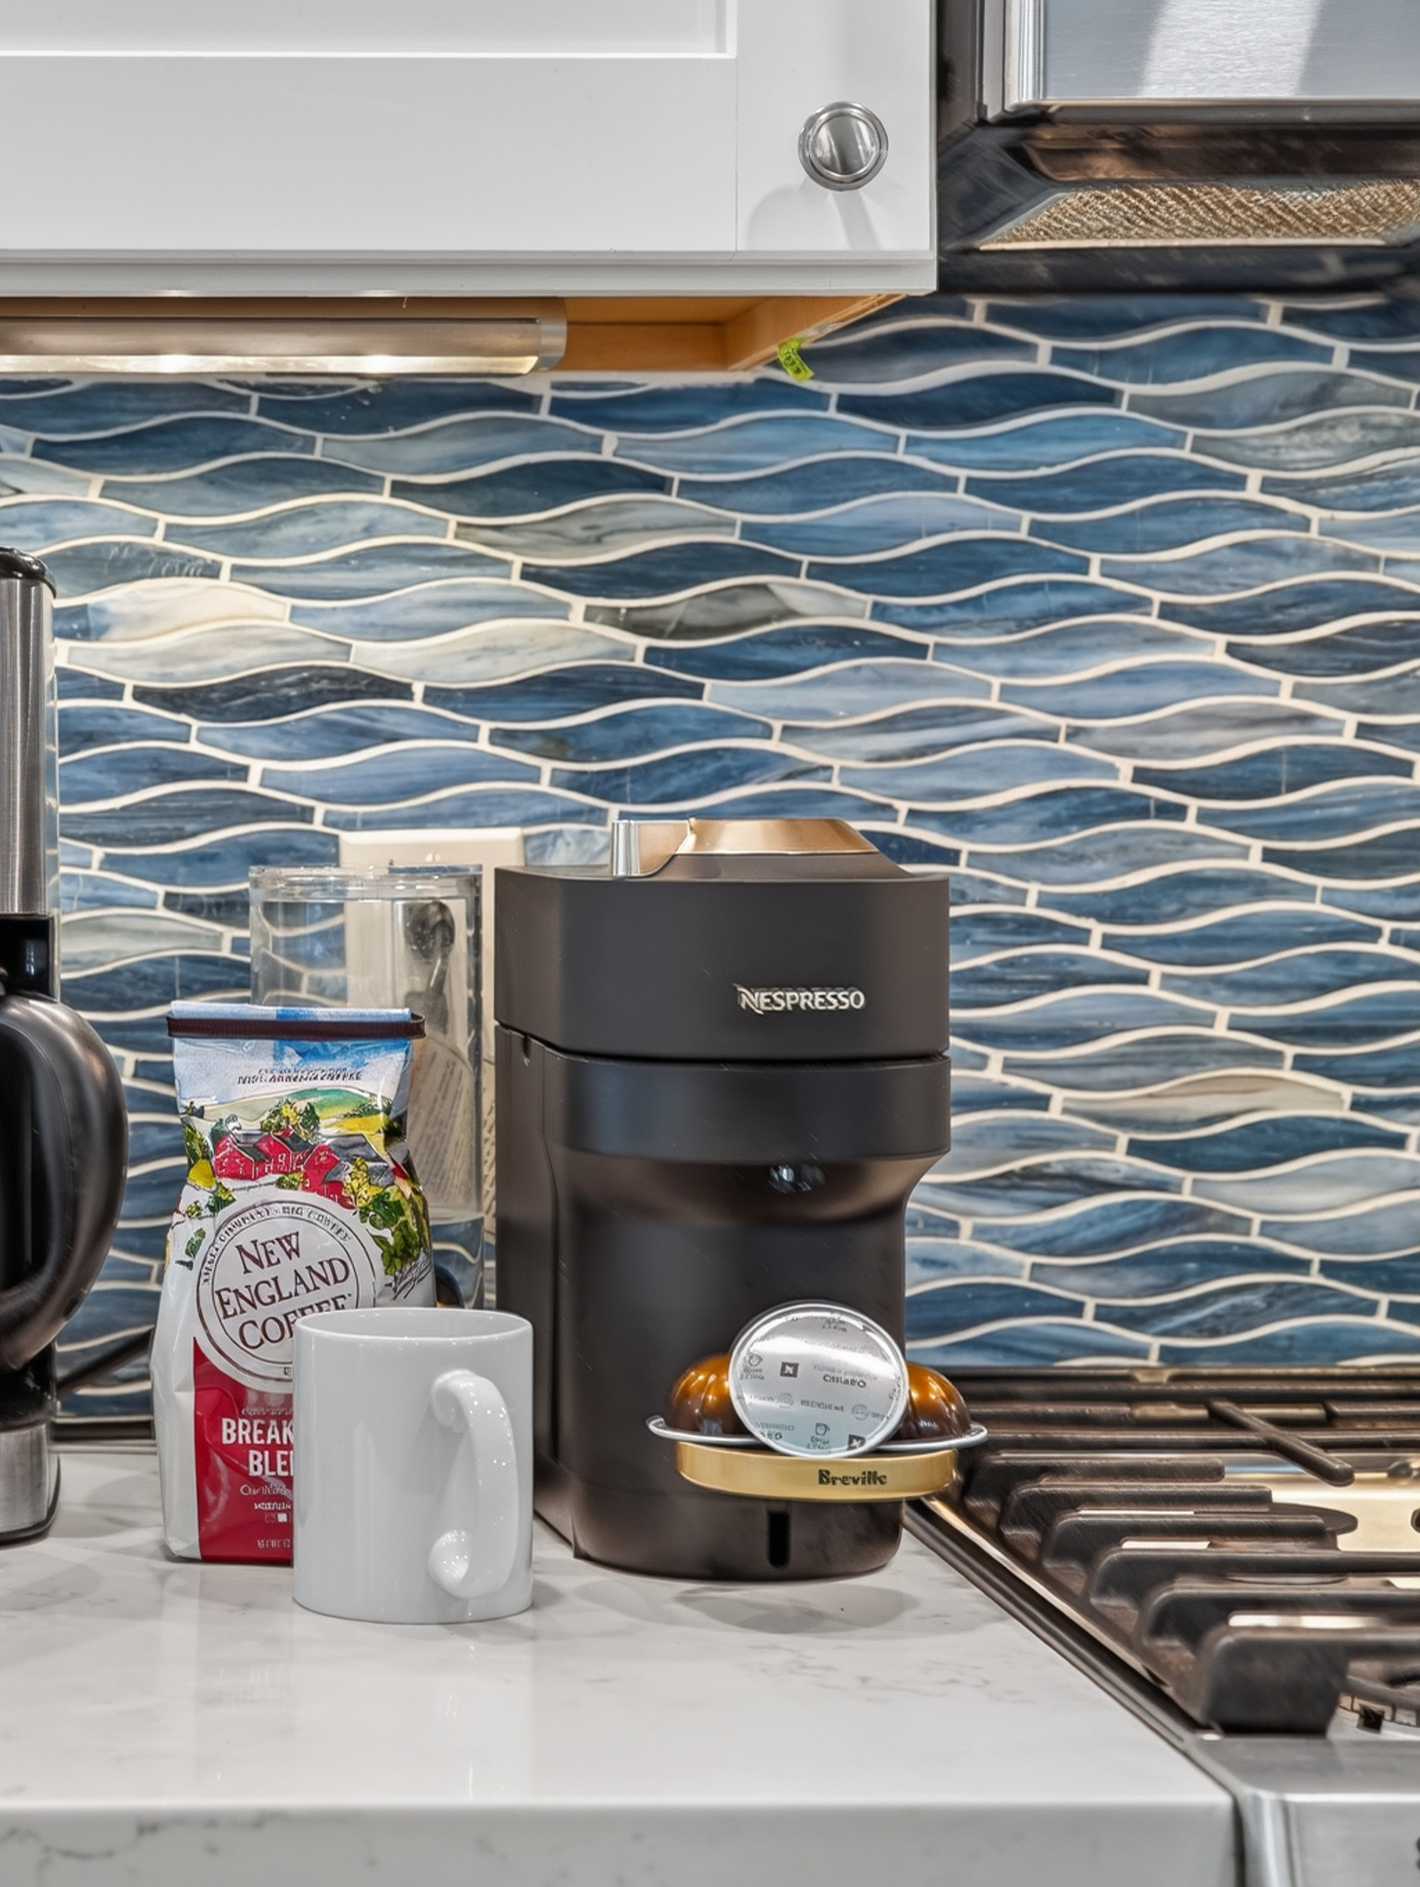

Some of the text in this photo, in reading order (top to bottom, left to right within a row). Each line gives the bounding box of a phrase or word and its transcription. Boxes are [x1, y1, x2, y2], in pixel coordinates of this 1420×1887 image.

[733, 984, 866, 1015] NESPRESSO
[235, 1231, 301, 1275] NEW
[214, 1257, 350, 1320] ENGLAND
[248, 1449, 294, 1477] BLE
[818, 1469, 888, 1486] Breville
